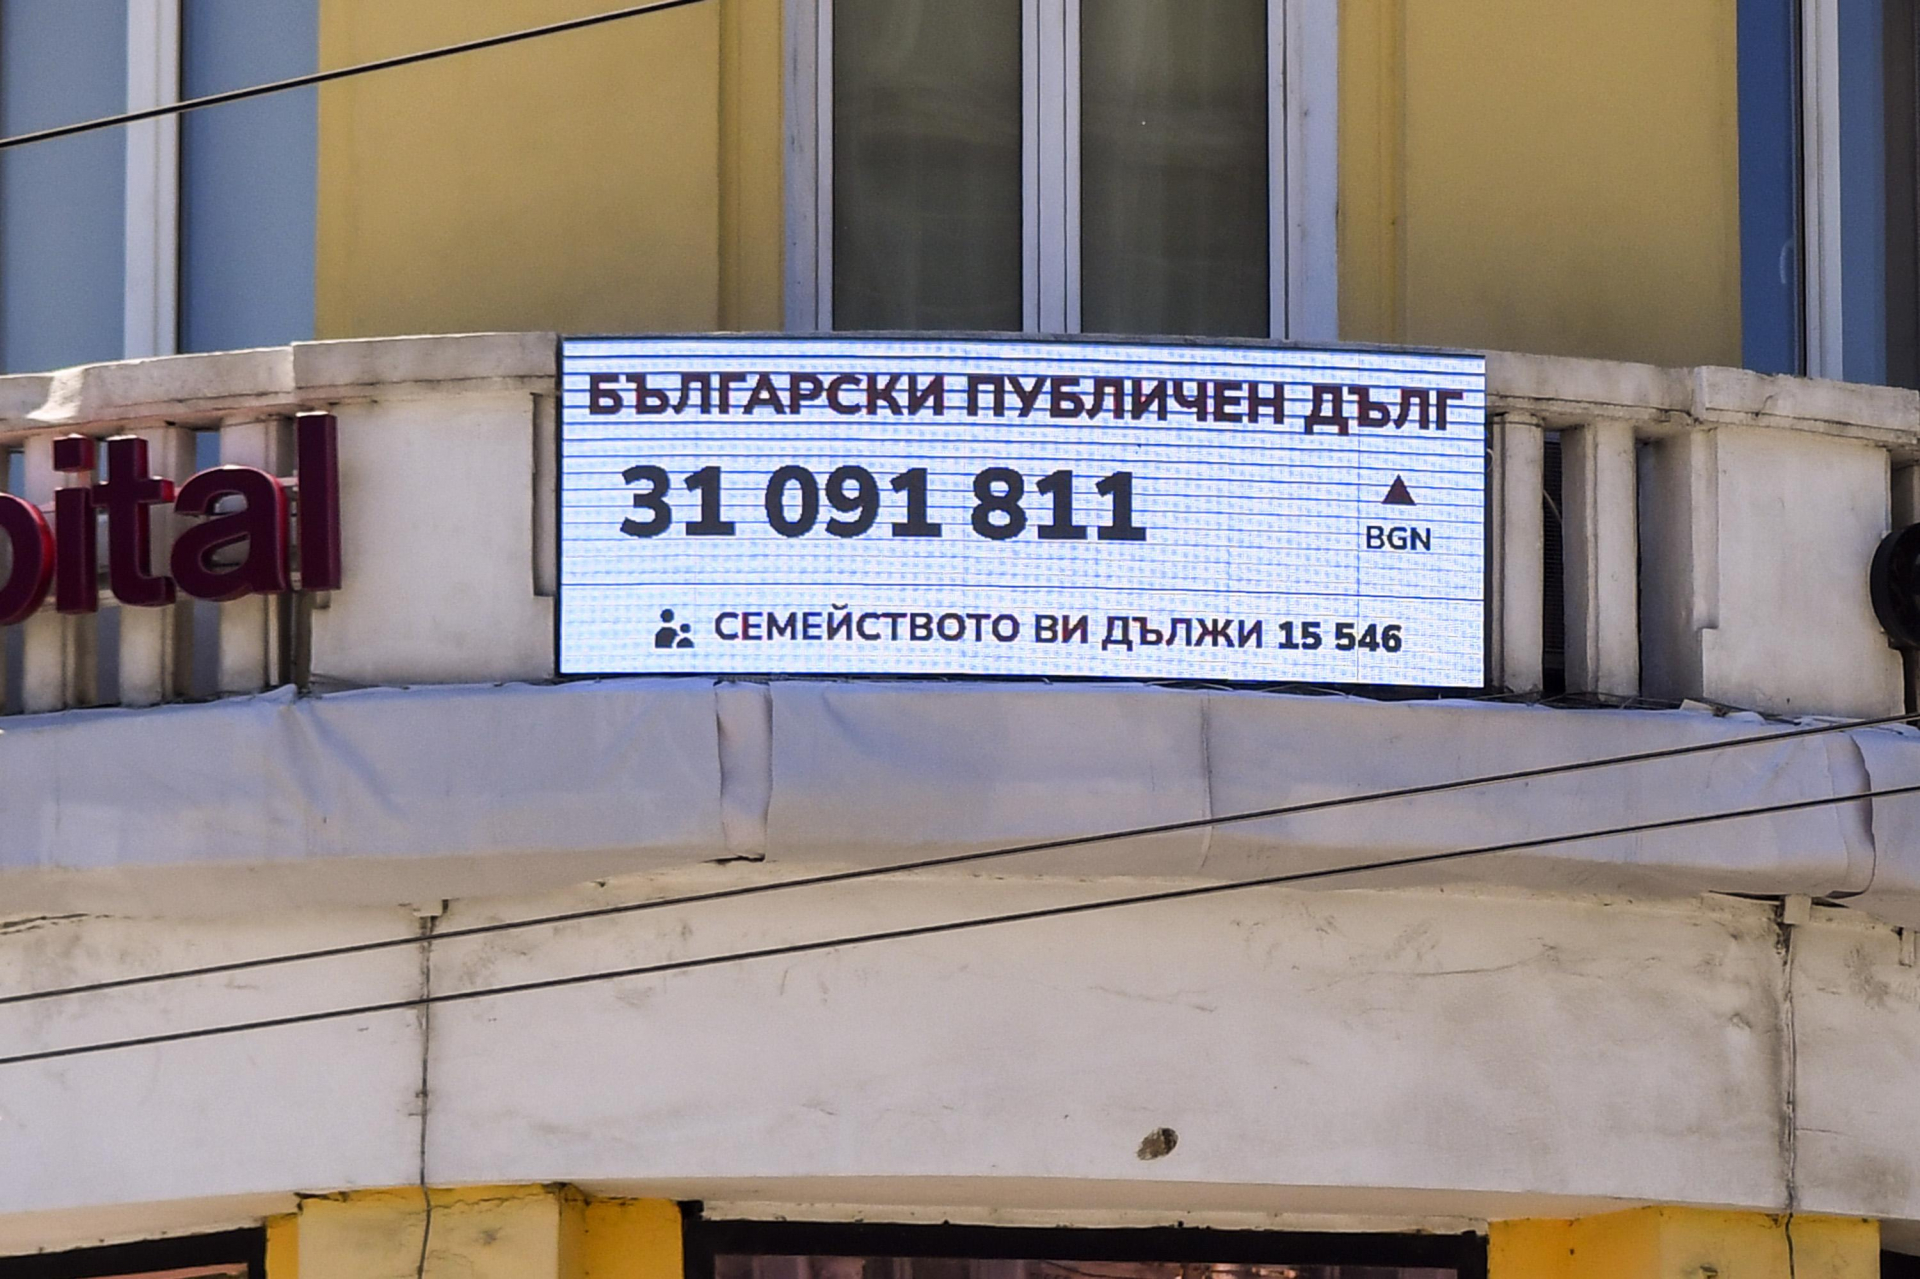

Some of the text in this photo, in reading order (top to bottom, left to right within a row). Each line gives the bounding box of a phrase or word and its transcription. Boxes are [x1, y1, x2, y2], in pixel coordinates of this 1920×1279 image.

[588, 373, 1464, 436] БЪЛГАРСКИ ПУБЛИЧЕН ДЪЛГ
[620, 465, 1147, 541] 31 091 811
[1365, 525, 1432, 552] BGN
[714, 604, 1402, 654] СЕМЕЙСТВОТО ВИ ДЪЛЖИ 15 546
